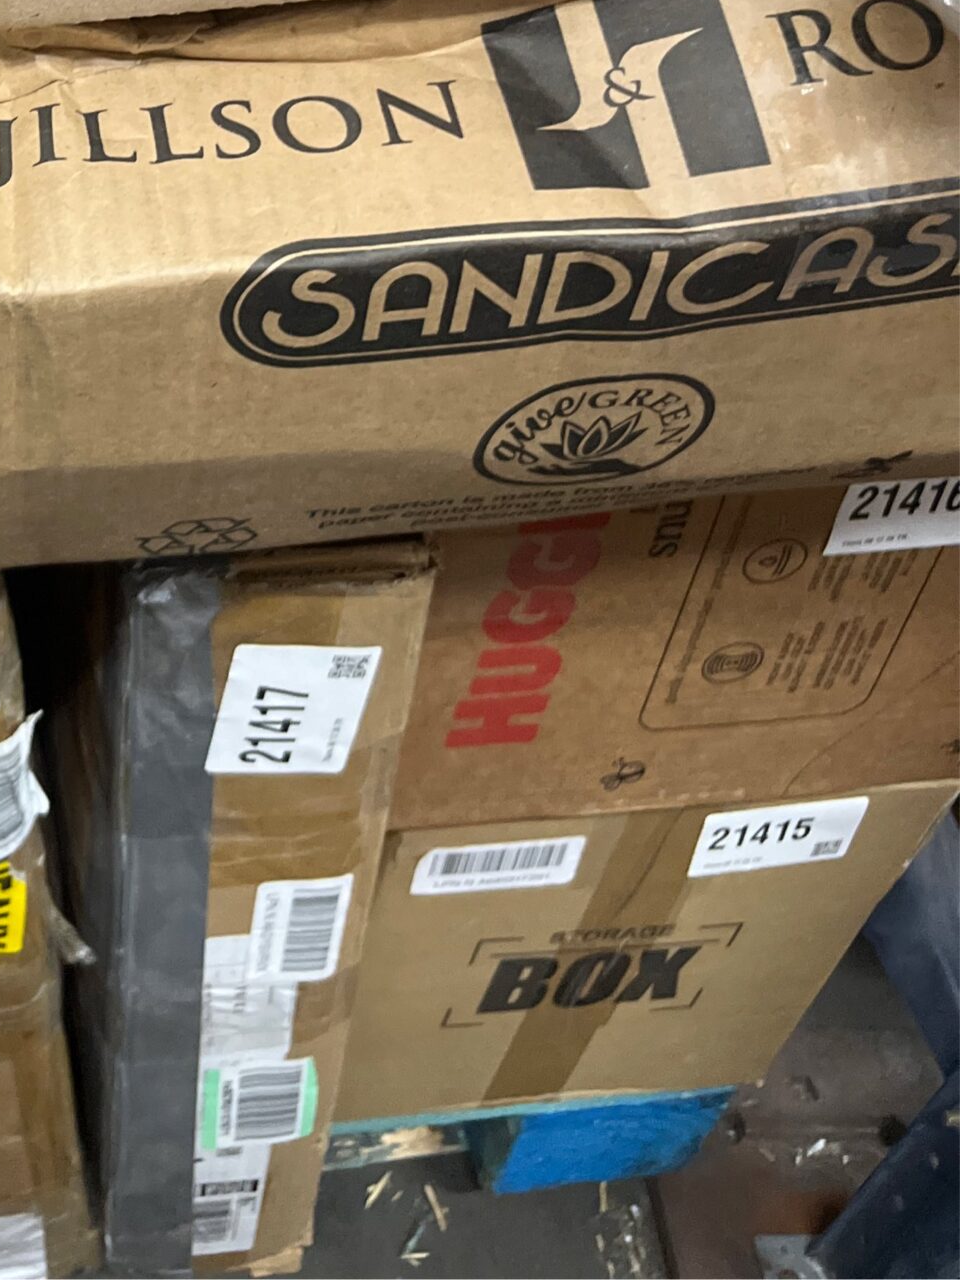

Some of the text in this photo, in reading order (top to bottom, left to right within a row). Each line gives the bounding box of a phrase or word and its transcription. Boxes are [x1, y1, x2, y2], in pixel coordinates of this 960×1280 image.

[261, 213, 960, 348] SANDICAS
[492, 387, 692, 465] give GREEN
[239, 685, 310, 763] 21417
[707, 816, 817, 851] 21415
[549, 923, 678, 945] STORAGE
[476, 944, 703, 1015] BOX
